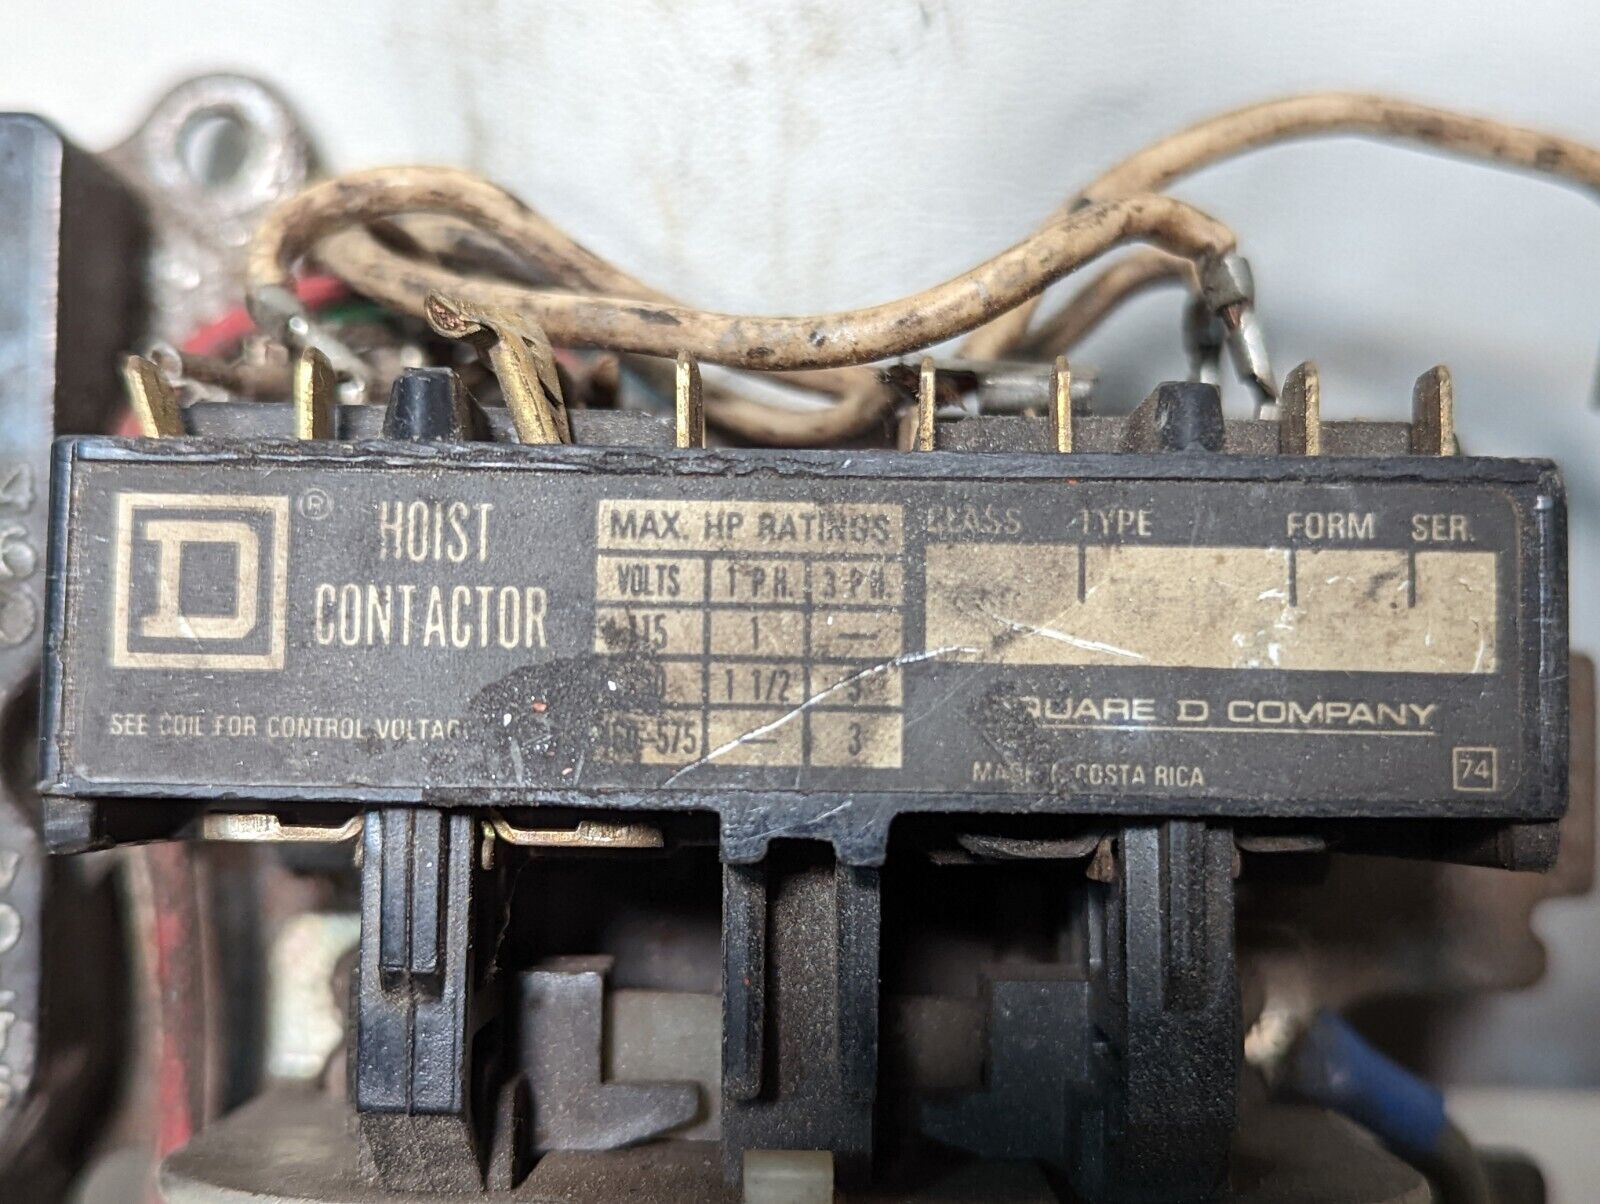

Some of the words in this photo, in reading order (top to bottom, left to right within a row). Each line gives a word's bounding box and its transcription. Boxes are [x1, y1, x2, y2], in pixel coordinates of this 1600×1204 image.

[379, 500, 495, 563] HOIST
[609, 508, 689, 541] MAX.
[703, 511, 744, 540] HP
[757, 511, 890, 545] RATINGS
[927, 504, 1023, 535] CLASS
[1080, 507, 1153, 537] TYPE
[1286, 512, 1376, 540] FORM
[1411, 513, 1476, 543] SER.
[617, 563, 681, 597] VOLTS
[314, 582, 548, 649] CONTACTOR
[110, 713, 148, 736] SEE
[160, 713, 204, 737] COIL
[212, 714, 257, 737] FOR
[267, 715, 367, 739] CONTROL
[1176, 699, 1210, 722] D
[1226, 700, 1437, 726] COMPANY
[848, 722, 863, 756] 3
[1075, 762, 1146, 787] COSTA
[1154, 765, 1205, 788] RICA
[1459, 756, 1489, 781] 74
